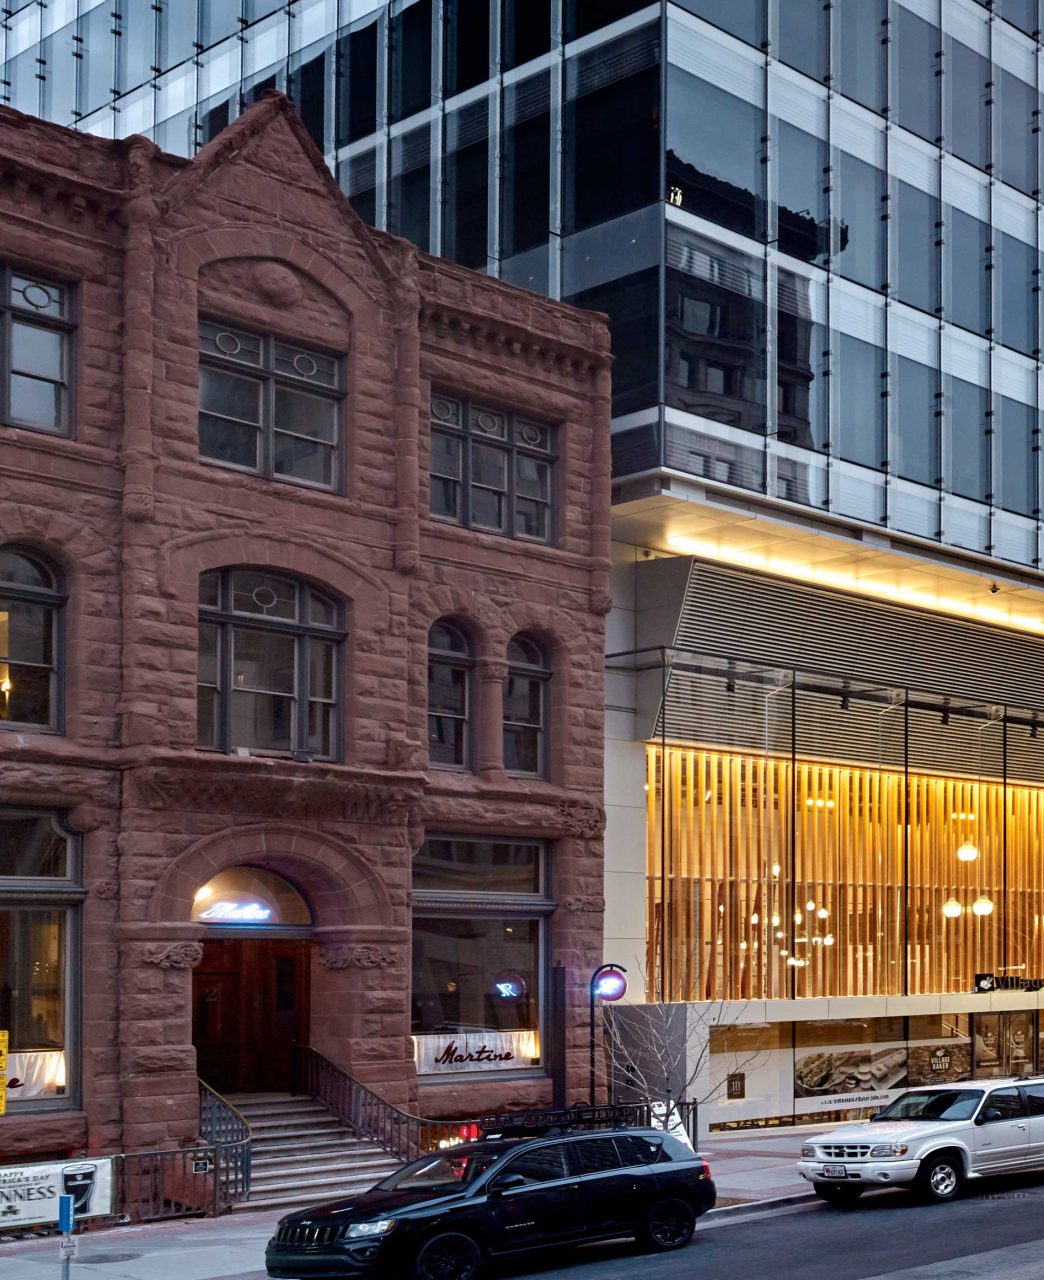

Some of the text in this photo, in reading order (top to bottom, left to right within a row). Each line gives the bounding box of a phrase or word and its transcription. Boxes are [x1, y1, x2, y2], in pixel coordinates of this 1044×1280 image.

[434, 1040, 515, 1065] Martine
[930, 1056, 951, 1064] VILLAGE
[31, 1174, 50, 1182] DAY
